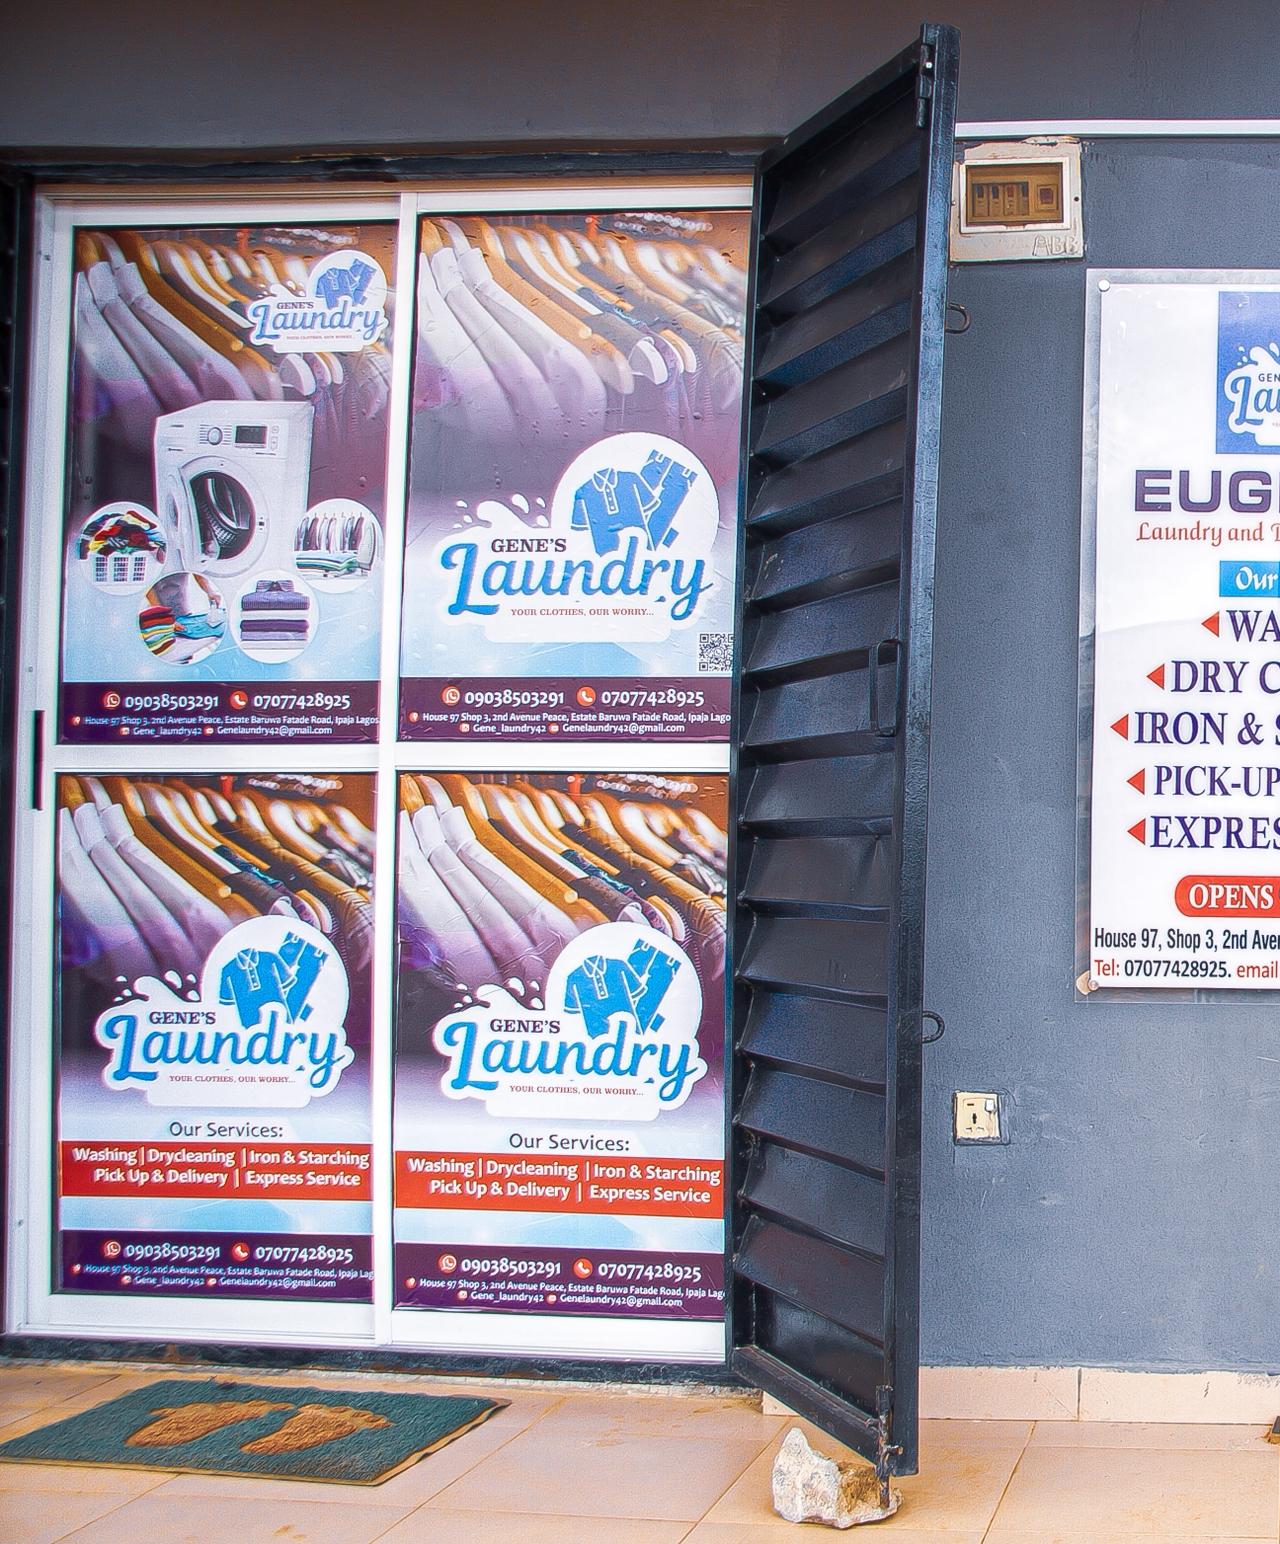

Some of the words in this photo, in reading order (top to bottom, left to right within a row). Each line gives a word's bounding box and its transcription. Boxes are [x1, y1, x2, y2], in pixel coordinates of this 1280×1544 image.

[252, 300, 384, 340] Laundry
[1136, 521, 1222, 546] Laundry
[1228, 521, 1263, 542] and
[491, 539, 566, 552] GENE'S
[441, 536, 714, 620] Laundry
[1235, 567, 1278, 590] Our
[540, 609, 586, 617] CLOTHES,
[1171, 660, 1249, 693] DRY
[125, 694, 219, 710] 09038503291
[254, 693, 350, 710] 07077428925
[465, 689, 564, 707] 09038503291
[602, 690, 704, 708] 07077428925
[423, 713, 448, 721] House
[450, 714, 459, 723] 97
[461, 713, 482, 723] Shop
[493, 713, 507, 721] 2nd
[510, 713, 540, 721] Avenue
[543, 713, 569, 723] Peace,
[571, 713, 596, 721] Estate
[599, 713, 630, 721] Baruwa
[633, 713, 660, 721] Fatade
[663, 713, 686, 723] Road,
[689, 713, 708, 724] Ipaja
[473, 723, 546, 733] Gene_laundry42
[562, 723, 685, 733] Genelaundry42@gmail.com
[1134, 711, 1228, 744] IRON
[1238, 713, 1264, 745] &
[1189, 885, 1274, 909] OPENS
[1095, 928, 1136, 948] House
[1141, 928, 1161, 951] 97,
[1167, 928, 1200, 953] Shop
[1206, 929, 1217, 951] 3,
[1223, 930, 1246, 950] 2nd
[1095, 959, 1119, 976] Tel:
[1125, 960, 1231, 978] 07077428925.
[150, 1012, 216, 1025] GENE'S
[490, 1019, 560, 1033] GENE'S
[105, 1011, 345, 1088] Laundry
[444, 1021, 698, 1100] Laundry
[510, 1085, 534, 1093] YOUR
[537, 1086, 580, 1094] CLOTHES,
[170, 1122, 201, 1137] Our
[207, 1122, 283, 1137] Services:
[509, 1133, 542, 1149] Our
[549, 1135, 629, 1151] Services:
[73, 1148, 136, 1166] Washing
[148, 1148, 235, 1167] Drycleaning
[250, 1151, 280, 1164] Iron
[283, 1151, 295, 1164] &
[299, 1151, 370, 1168] Starching
[95, 1168, 125, 1182] Pick
[129, 1169, 150, 1187] Up
[153, 1169, 164, 1183] &
[168, 1170, 228, 1187] Delivery
[246, 1172, 304, 1188] Express
[307, 1172, 360, 1185] Service
[408, 1158, 474, 1176] Washing
[487, 1161, 578, 1180] Drycleaning
[595, 1164, 625, 1179] Iron
[630, 1166, 642, 1179] &
[646, 1166, 720, 1186] Starching
[431, 1180, 462, 1194] Pick
[465, 1182, 487, 1199] Up
[491, 1182, 503, 1195] &
[507, 1182, 570, 1200] Delivery
[590, 1185, 649, 1202] Express
[653, 1187, 711, 1202] Service
[126, 1243, 220, 1261] 09038503291
[256, 1246, 353, 1264] 07077428925
[461, 1258, 561, 1276] 09038503291
[598, 1262, 701, 1281] 07077428925
[560, 1293, 682, 1306] Genelaundry42@gmail.com
